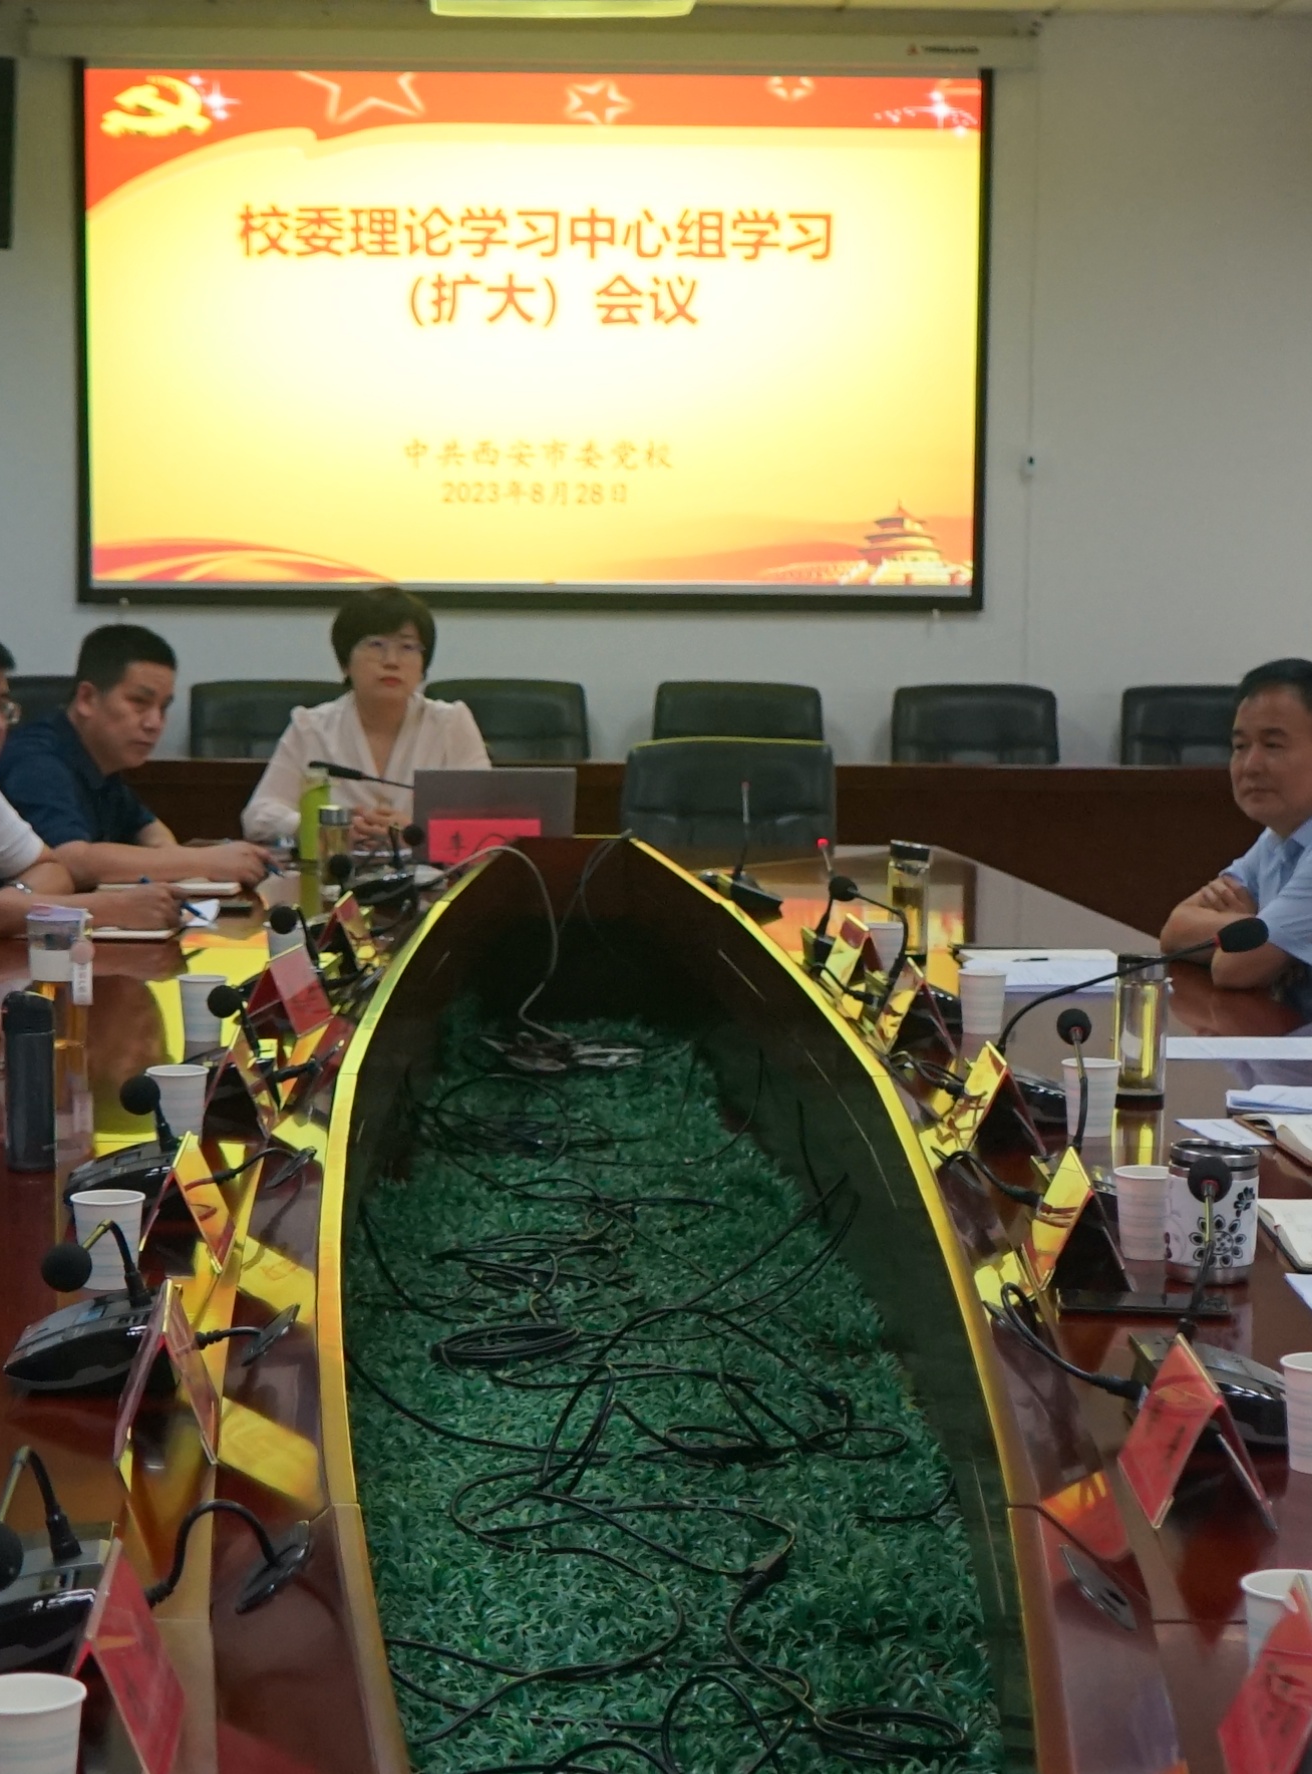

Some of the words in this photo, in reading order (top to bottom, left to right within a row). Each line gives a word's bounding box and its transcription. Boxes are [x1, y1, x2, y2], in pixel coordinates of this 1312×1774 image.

[237, 204, 833, 260] 校委理论学习中心组学习
[409, 273, 698, 326] （扩大）会议
[402, 438, 673, 471] 中共西安市委党校
[441, 480, 629, 506] 2023年8月28日
